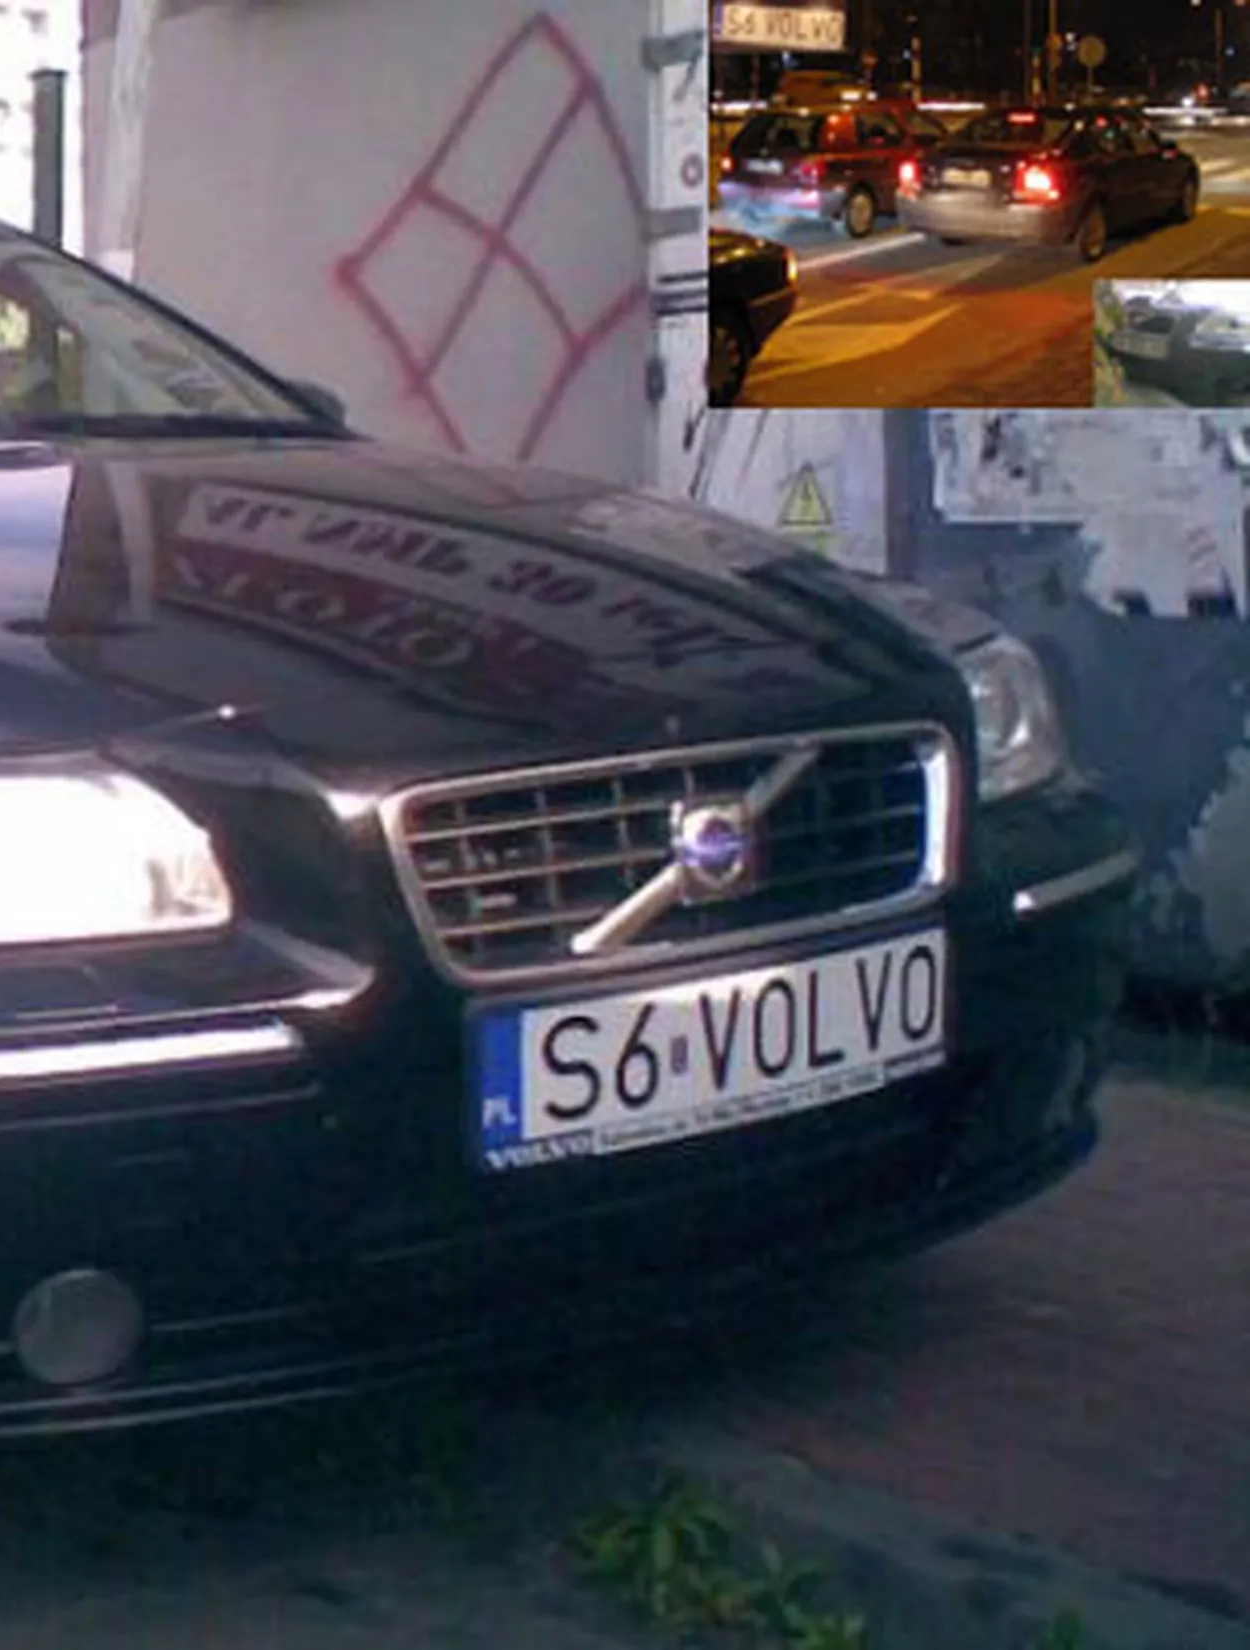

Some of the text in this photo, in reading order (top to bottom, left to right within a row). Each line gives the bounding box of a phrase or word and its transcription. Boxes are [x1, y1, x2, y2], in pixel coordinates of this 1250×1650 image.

[764, 10, 840, 44] VOLVO
[541, 944, 937, 1119] S6 VOLVO
[483, 1095, 517, 1128] PL
